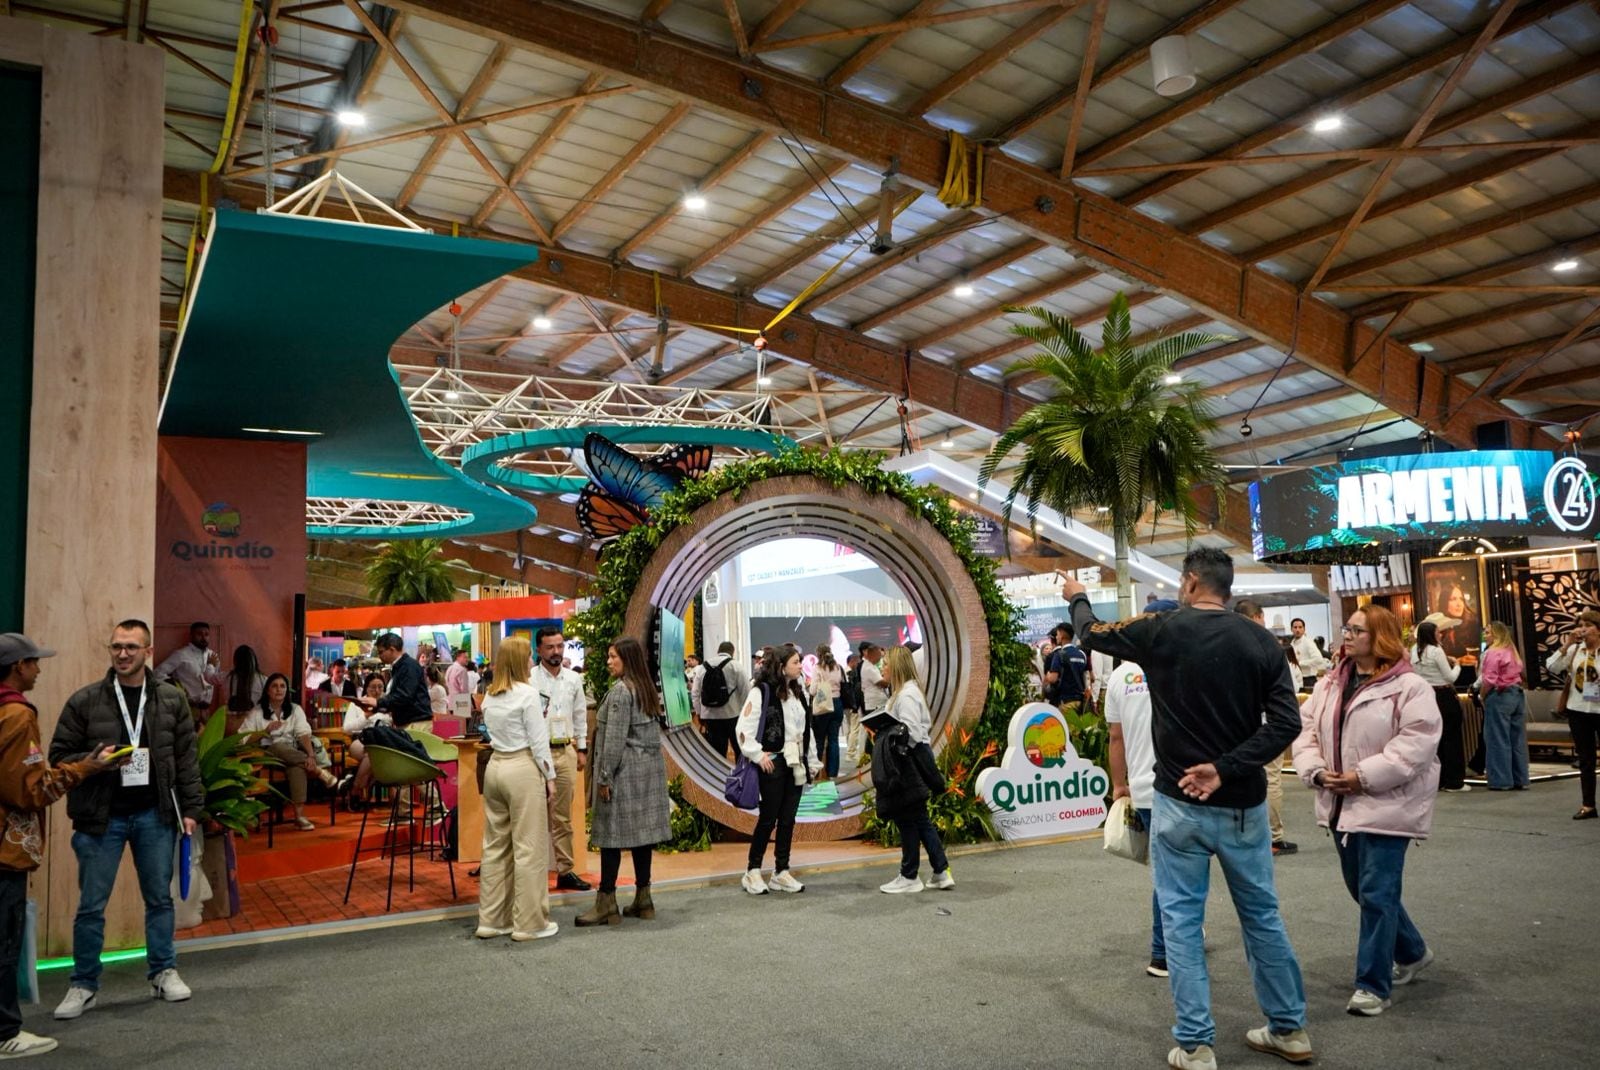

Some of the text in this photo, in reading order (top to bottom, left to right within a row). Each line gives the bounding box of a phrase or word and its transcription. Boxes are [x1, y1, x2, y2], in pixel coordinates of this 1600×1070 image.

[1337, 465, 1589, 529] ARMENIA 24
[171, 540, 274, 561] Quindío
[992, 769, 1106, 812] Quindío
[1045, 812, 1057, 823] DE
[1058, 806, 1104, 820] COLOMBIA
